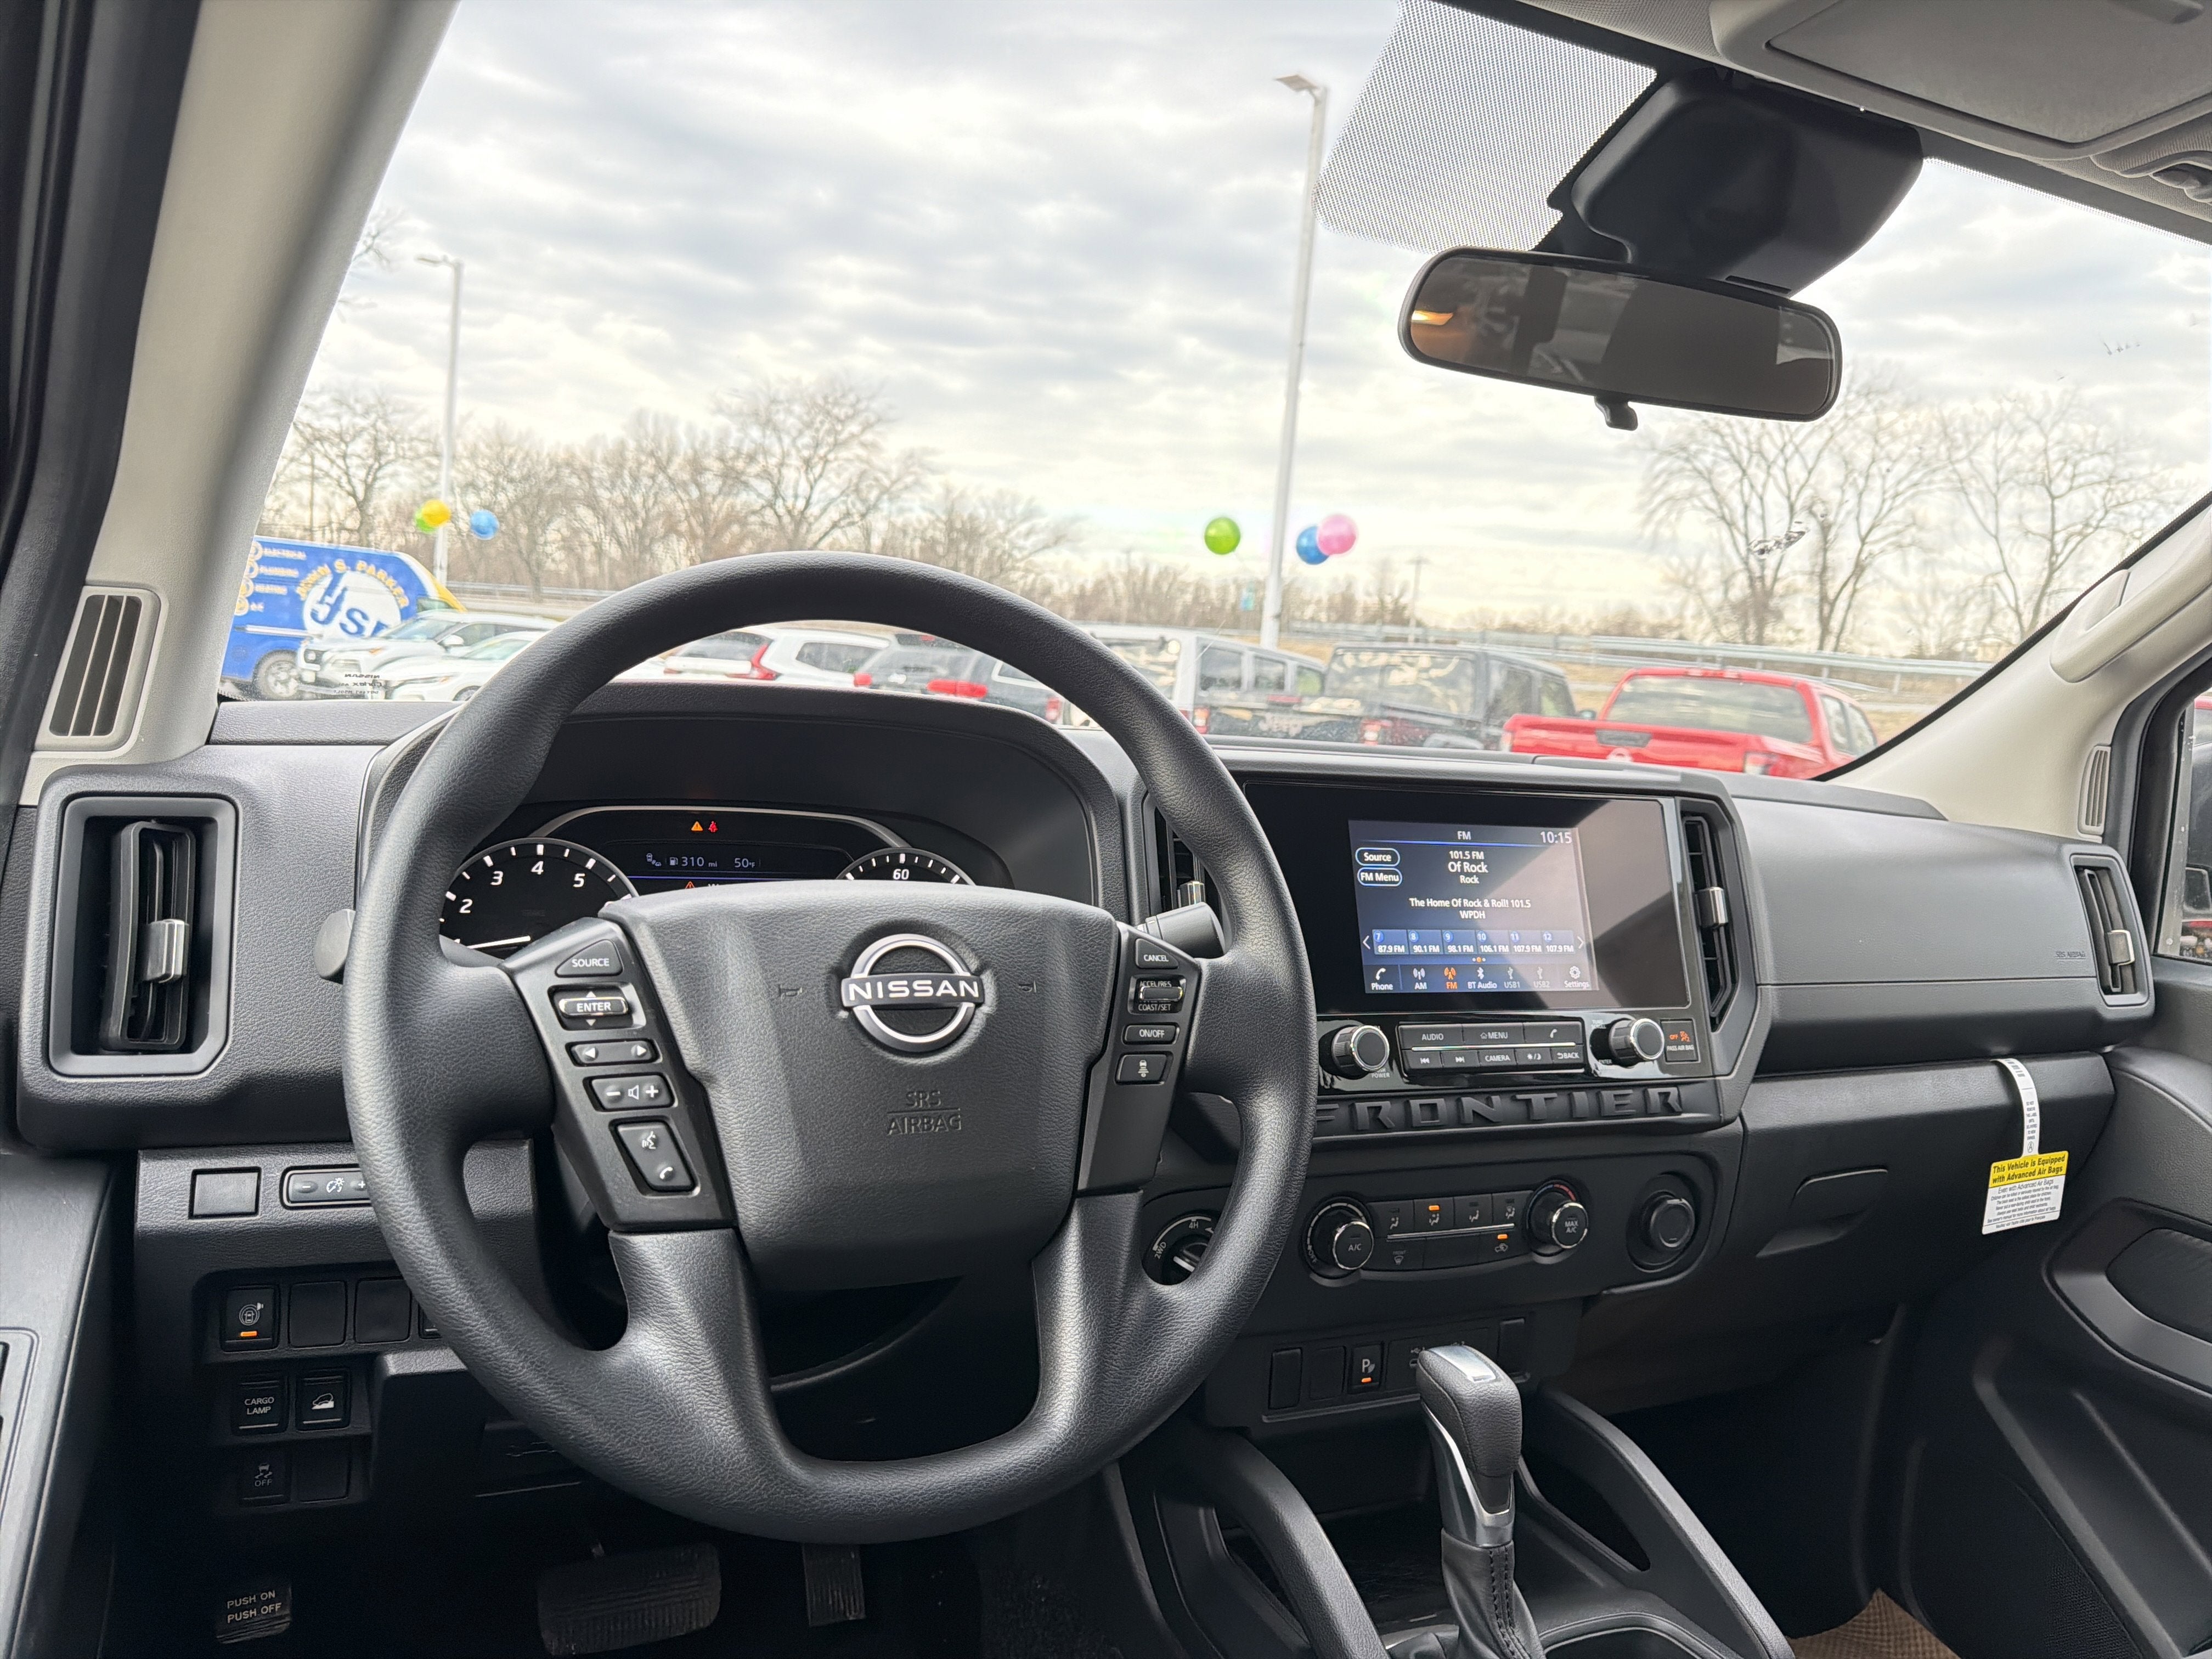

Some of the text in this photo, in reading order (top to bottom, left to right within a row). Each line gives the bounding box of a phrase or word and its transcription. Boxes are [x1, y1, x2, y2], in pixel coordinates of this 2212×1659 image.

[1259, 713, 1301, 736] Jeep
[1457, 831, 1472, 840] FM
[1541, 831, 1572, 844] 10:15
[1363, 852, 1392, 862] Source
[1449, 851, 1485, 860] 101.5 FM
[681, 856, 704, 867] 310
[531, 861, 544, 875] 4
[1448, 861, 1489, 873] Of Rock
[490, 871, 504, 885] 3
[893, 868, 910, 880] 60
[1361, 872, 1400, 882] FM Menu
[573, 873, 585, 888] 5
[1459, 875, 1480, 884] Rock
[459, 899, 473, 913] 2
[1409, 898, 1532, 908] The Home Of Rock & Roll! 101.5
[1459, 910, 1486, 919] WPDH
[1378, 945, 1405, 953] 87.9 FM
[1413, 945, 1440, 953] 90.1 FM
[1447, 945, 1474, 953] 98.1 FM
[572, 958, 610, 967] SOURCE
[1564, 980, 1590, 990] Settings
[849, 980, 979, 1001] NISSAN
[576, 1002, 612, 1012] ENTER
[1139, 1029, 1165, 1038] ON/OFF
[906, 1091, 941, 1108] SRS
[887, 1114, 962, 1135] AIRBAG
[1993, 1165, 2006, 1174] This
[2007, 1160, 2029, 1171] Vehicle
[2038, 1154, 2066, 1166] Equipped
[1992, 1165, 2063, 1184] with Advanced Air Bags
[2017, 1181, 2036, 1190] Advanced
[2044, 1178, 2055, 1187] Bags
[1188, 1221, 1199, 1229] 4H
[1154, 1242, 1166, 1260] 2WD
[244, 1396, 275, 1406] CARGO
[247, 1406, 272, 1415] LAMP
[255, 1479, 273, 1487] OFF
[227, 1590, 275, 1609] PUSH ON
[228, 1602, 282, 1624] PUSH OFF
